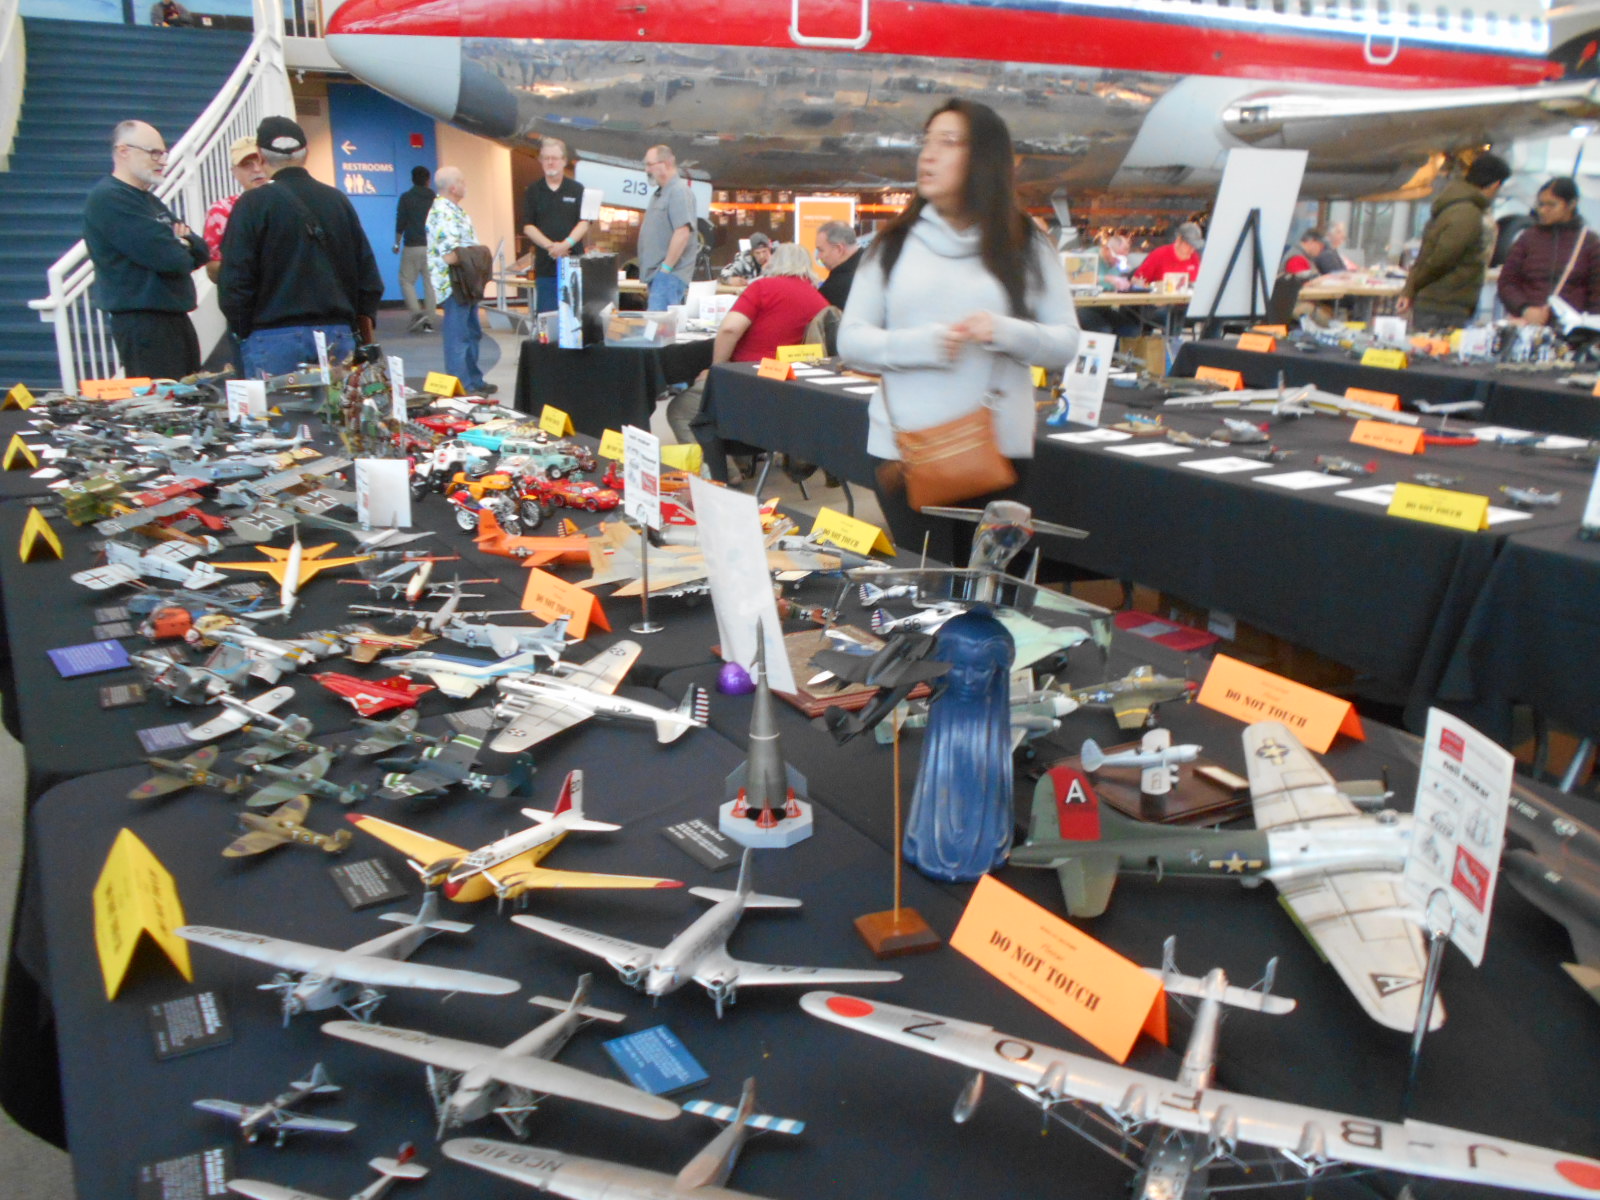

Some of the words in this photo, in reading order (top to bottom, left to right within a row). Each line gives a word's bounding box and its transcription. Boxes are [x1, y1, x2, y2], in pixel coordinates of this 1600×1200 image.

[342, 162, 395, 172] RESTROOMS
[622, 179, 649, 196] 213
[1225, 688, 1241, 703] DO
[1243, 694, 1266, 711] NOT
[1268, 705, 1309, 729] TOUCH
[1065, 777, 1087, 804] A
[988, 929, 1012, 953] DO
[1011, 943, 1046, 975] NOT
[1046, 965, 1102, 1012] TOUCH
